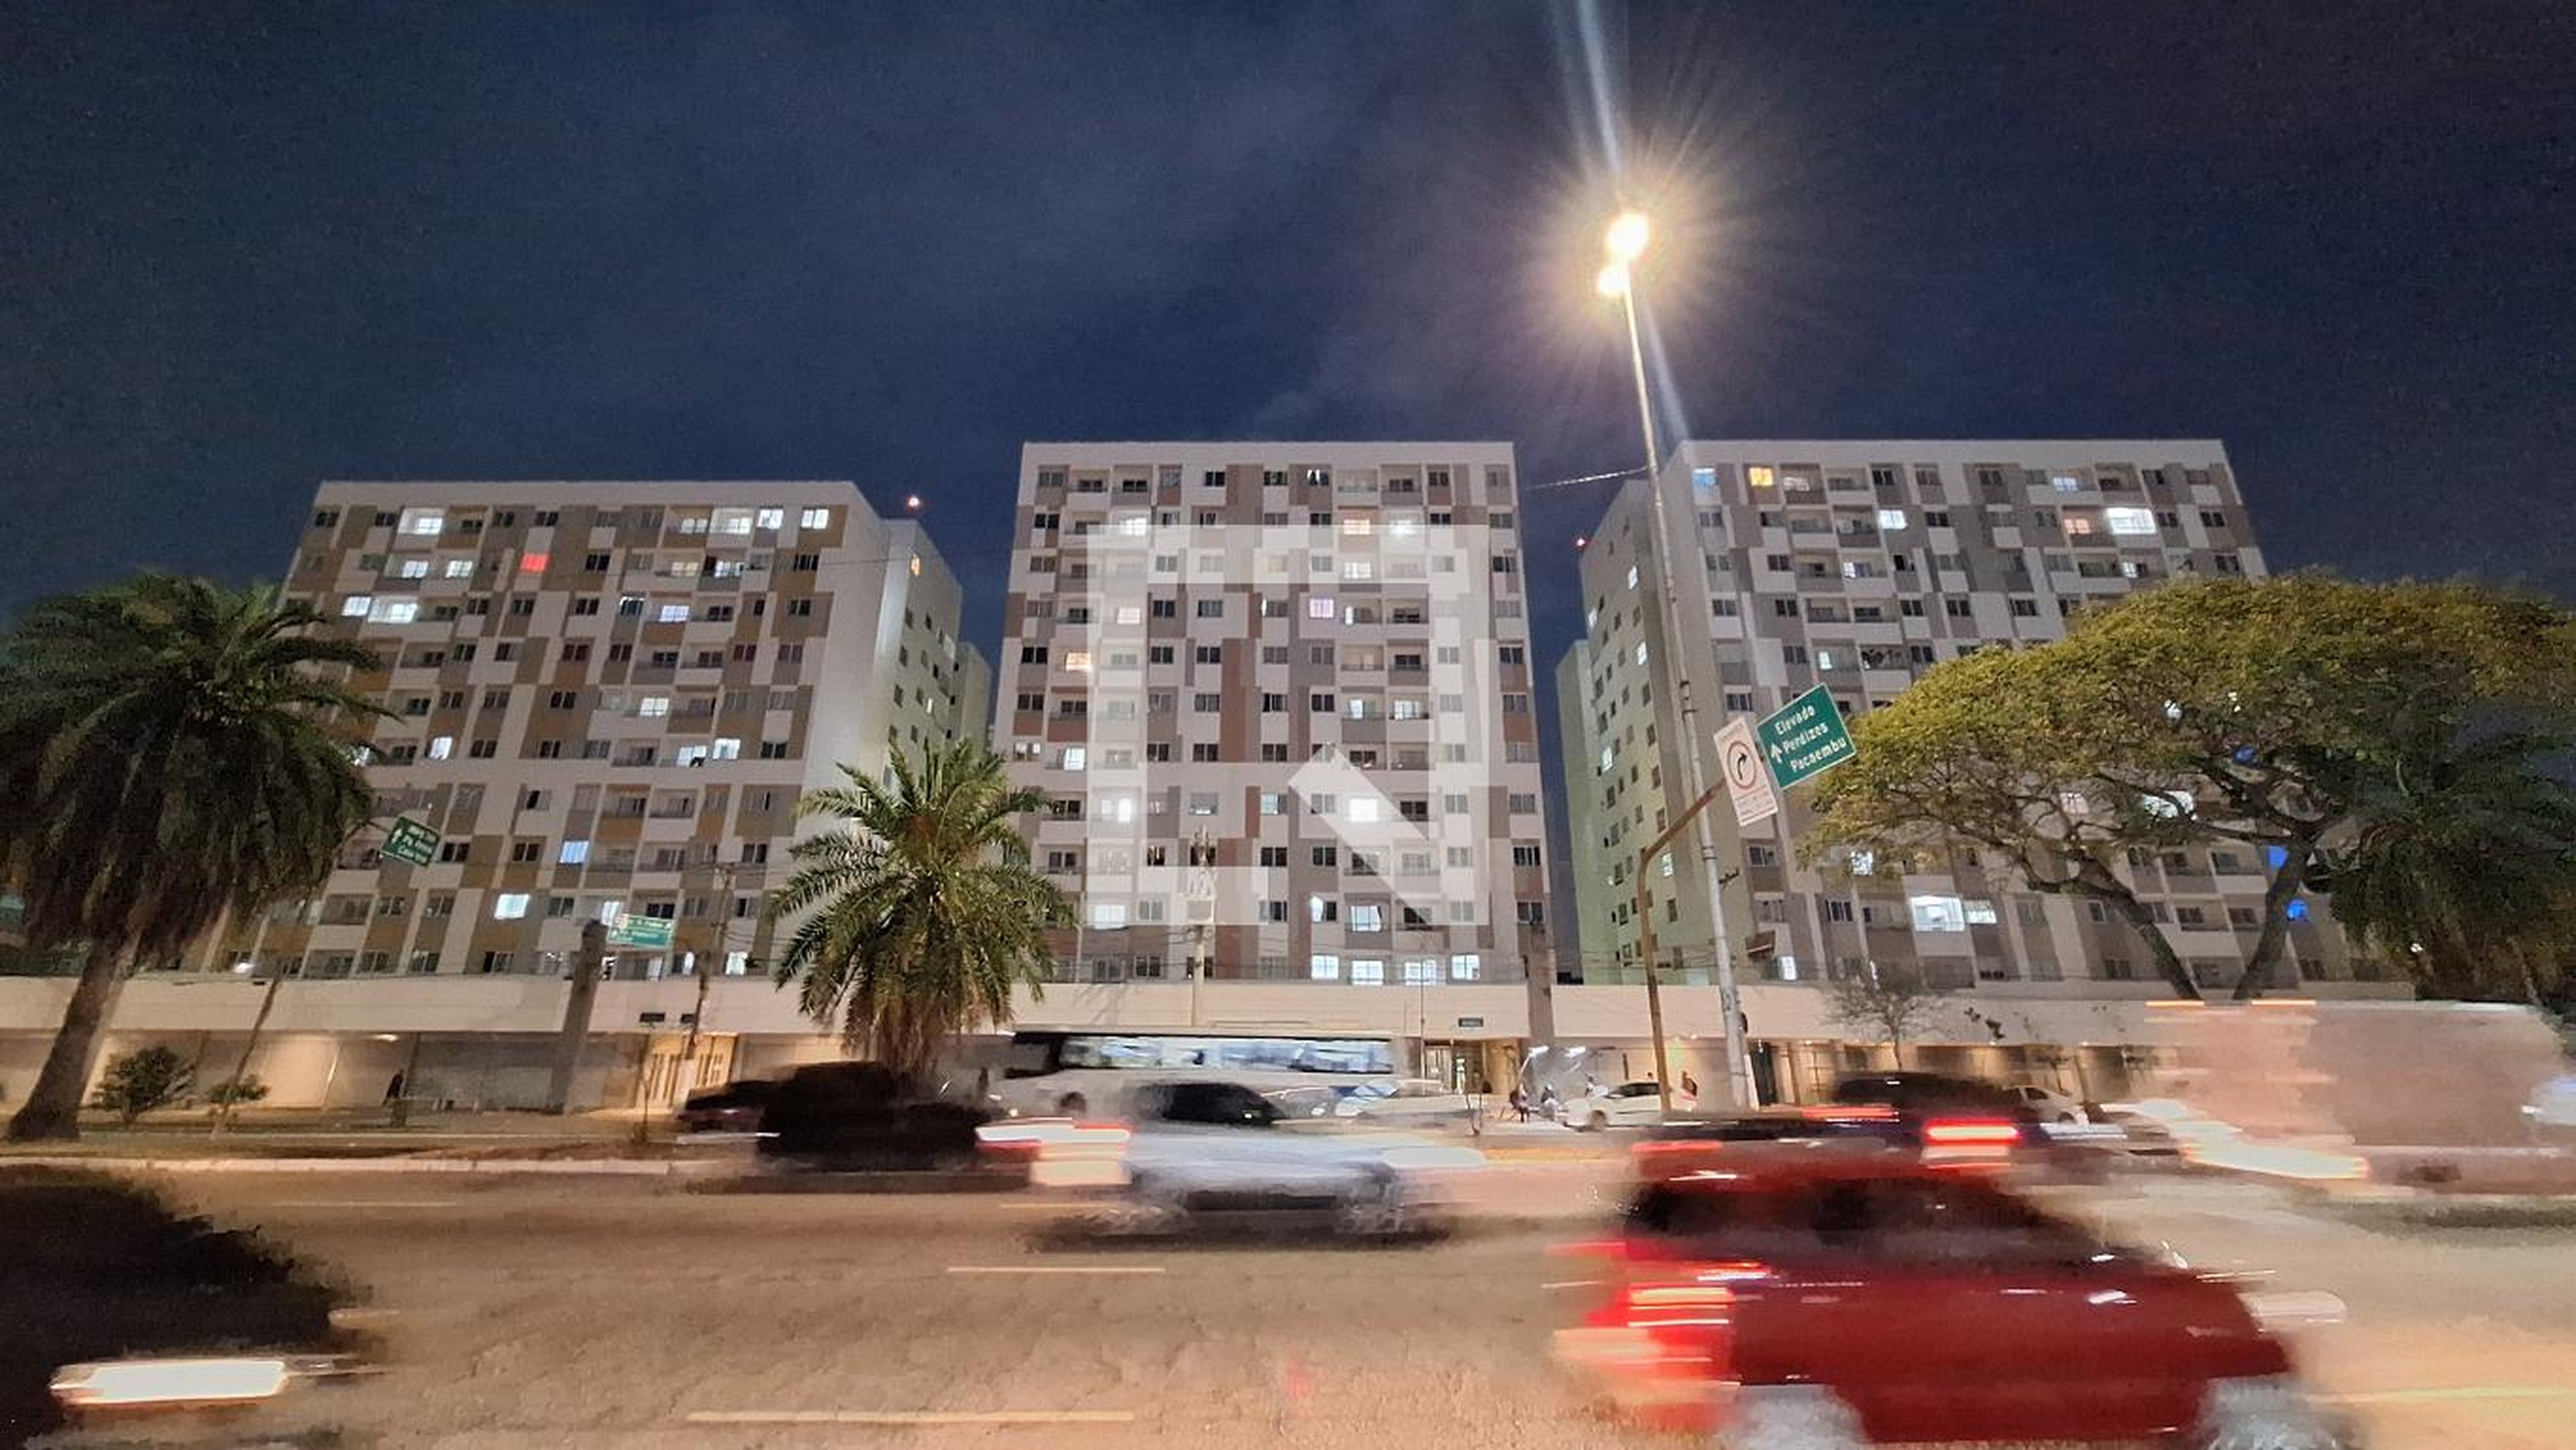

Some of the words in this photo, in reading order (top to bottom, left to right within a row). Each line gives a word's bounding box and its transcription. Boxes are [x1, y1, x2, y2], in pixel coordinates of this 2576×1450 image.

[1774, 705, 1815, 735] Elevado
[1782, 723, 1829, 754] Perdizes
[1790, 737, 1847, 773] Pacaembu
